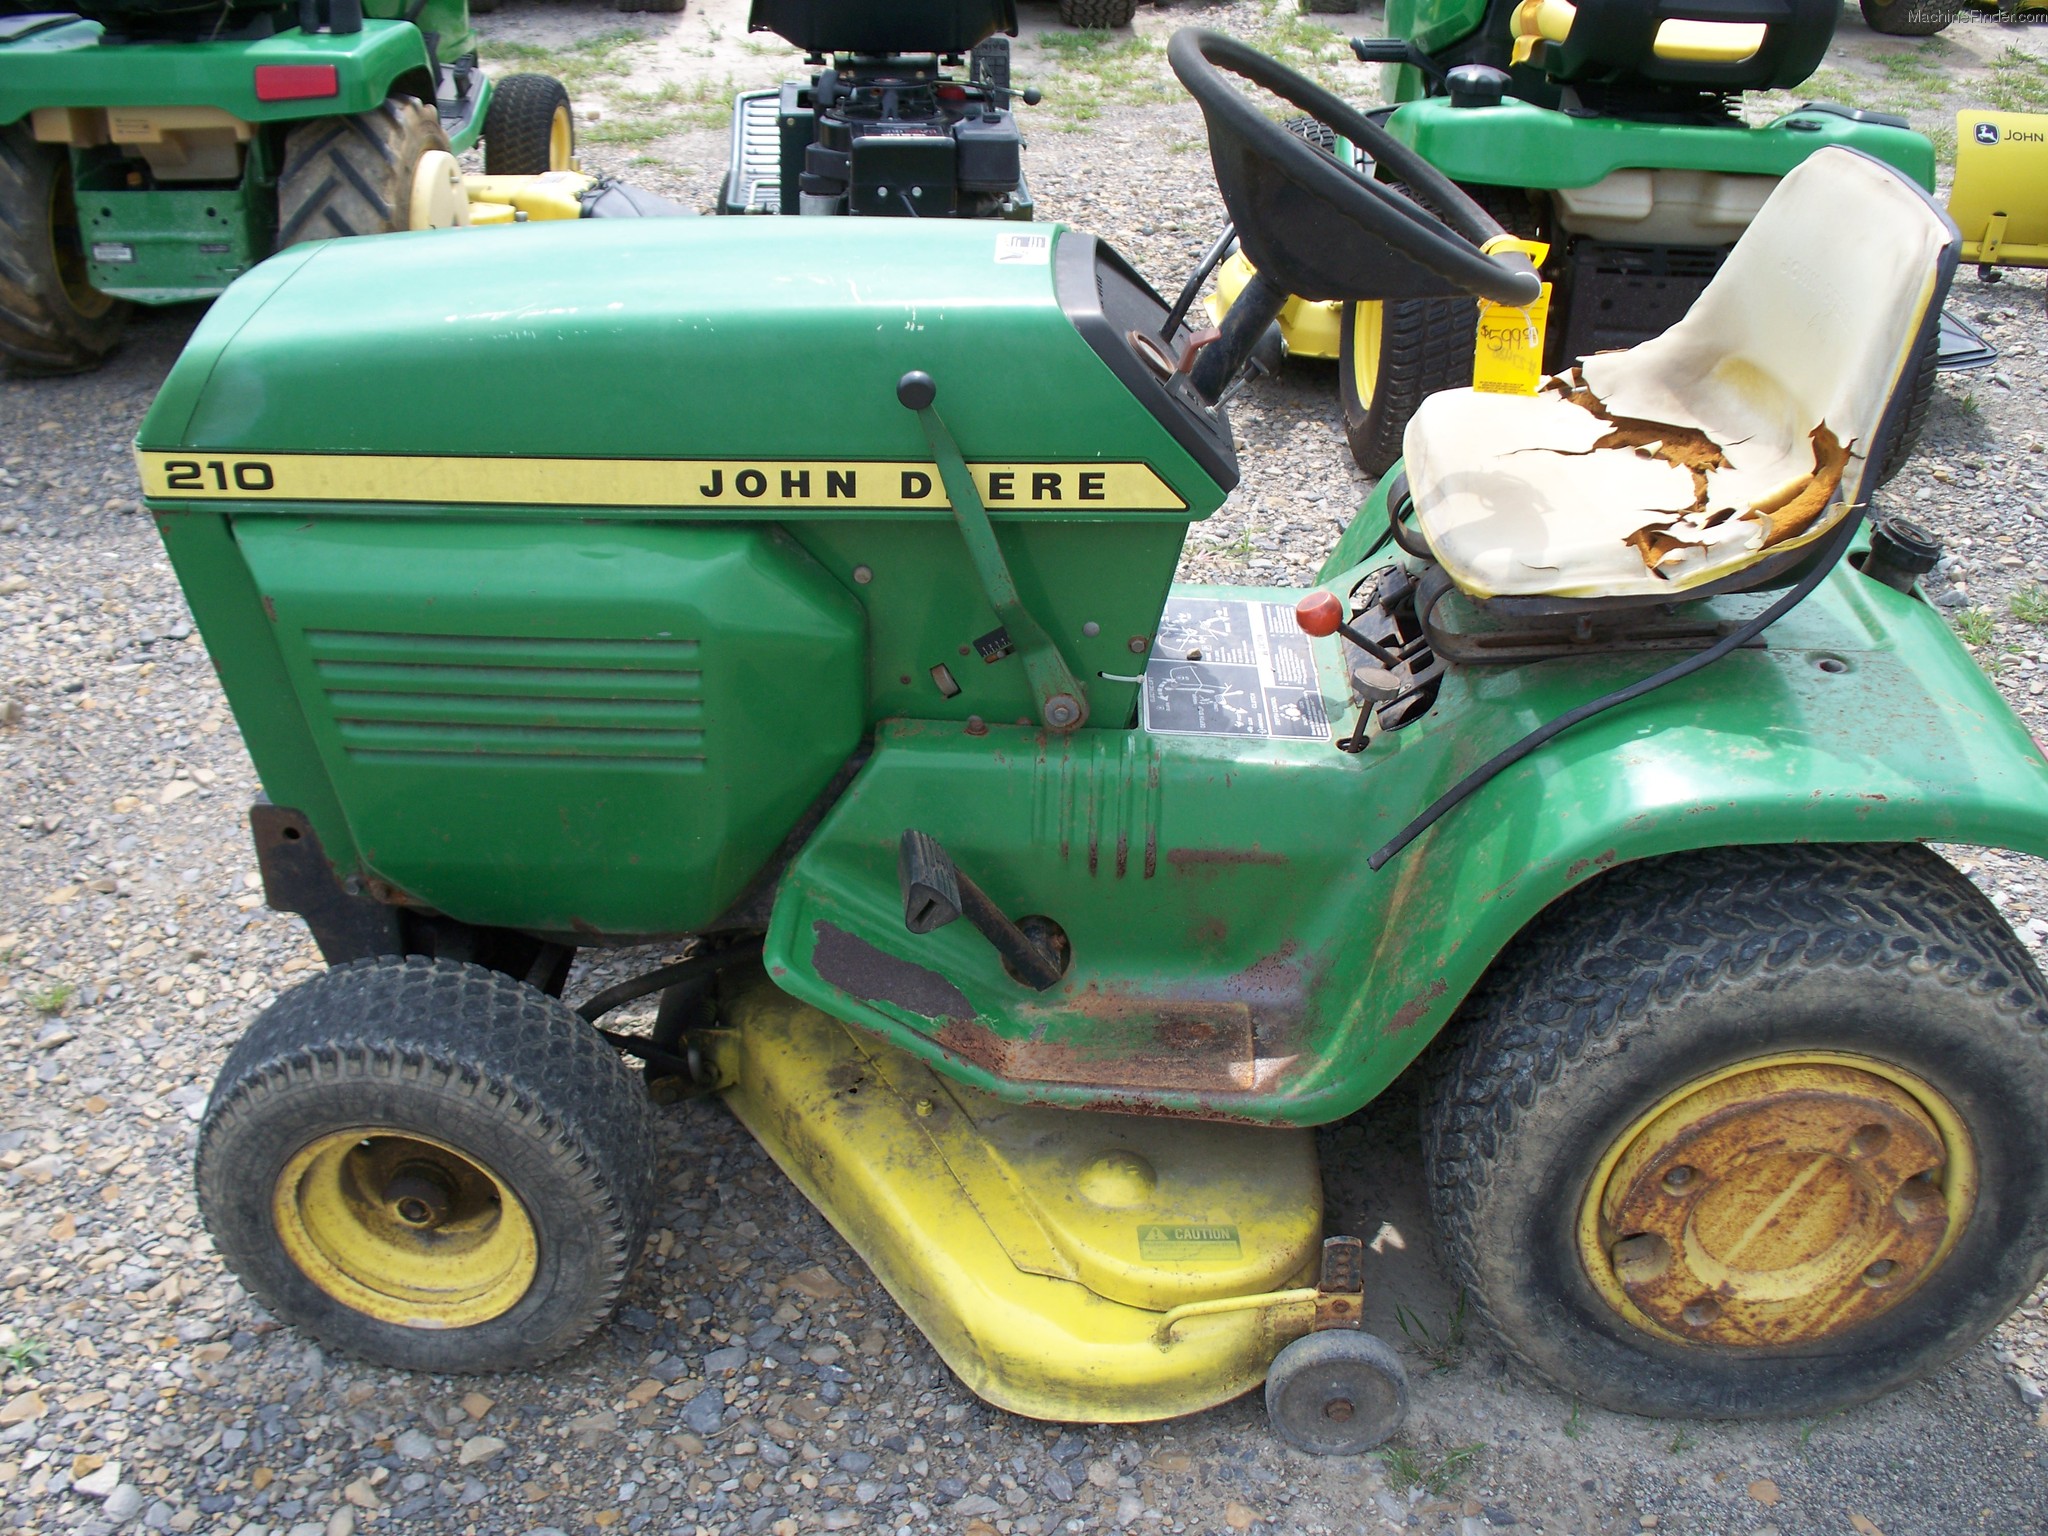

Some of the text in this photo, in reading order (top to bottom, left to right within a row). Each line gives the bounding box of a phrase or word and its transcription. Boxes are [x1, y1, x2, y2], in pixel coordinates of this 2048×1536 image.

[2004, 129, 2044, 142] JOHN
[164, 460, 275, 491] 210
[699, 468, 1106, 501] JOHN DERE
[1175, 1228, 1231, 1240] CAUTION
